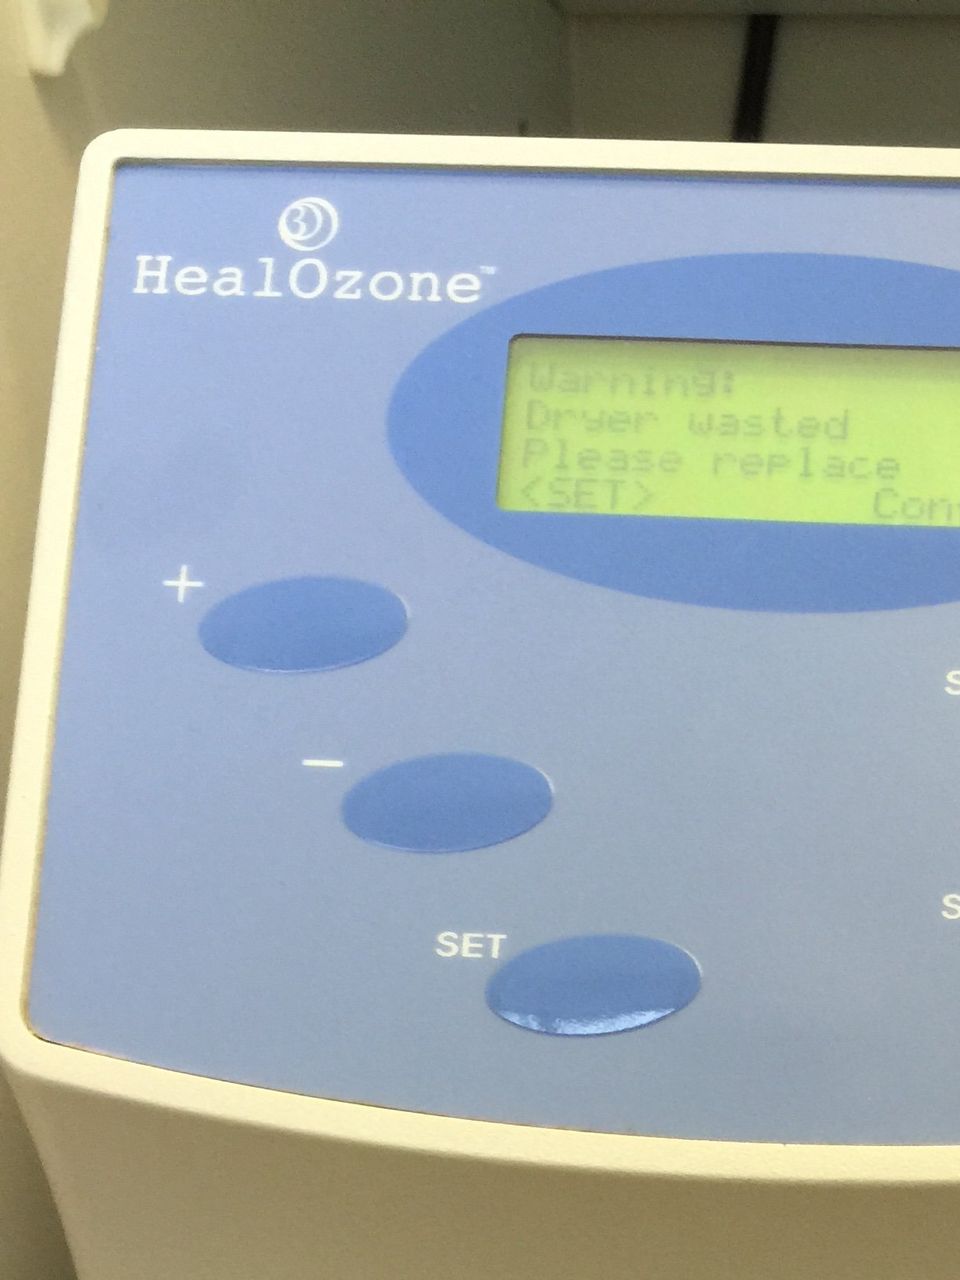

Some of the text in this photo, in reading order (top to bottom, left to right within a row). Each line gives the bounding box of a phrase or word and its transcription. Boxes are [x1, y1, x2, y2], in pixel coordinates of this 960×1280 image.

[528, 361, 737, 397] Warning:
[525, 400, 850, 440] Dryer wasted
[522, 438, 901, 482] Please replace
[435, 932, 508, 959] SET
